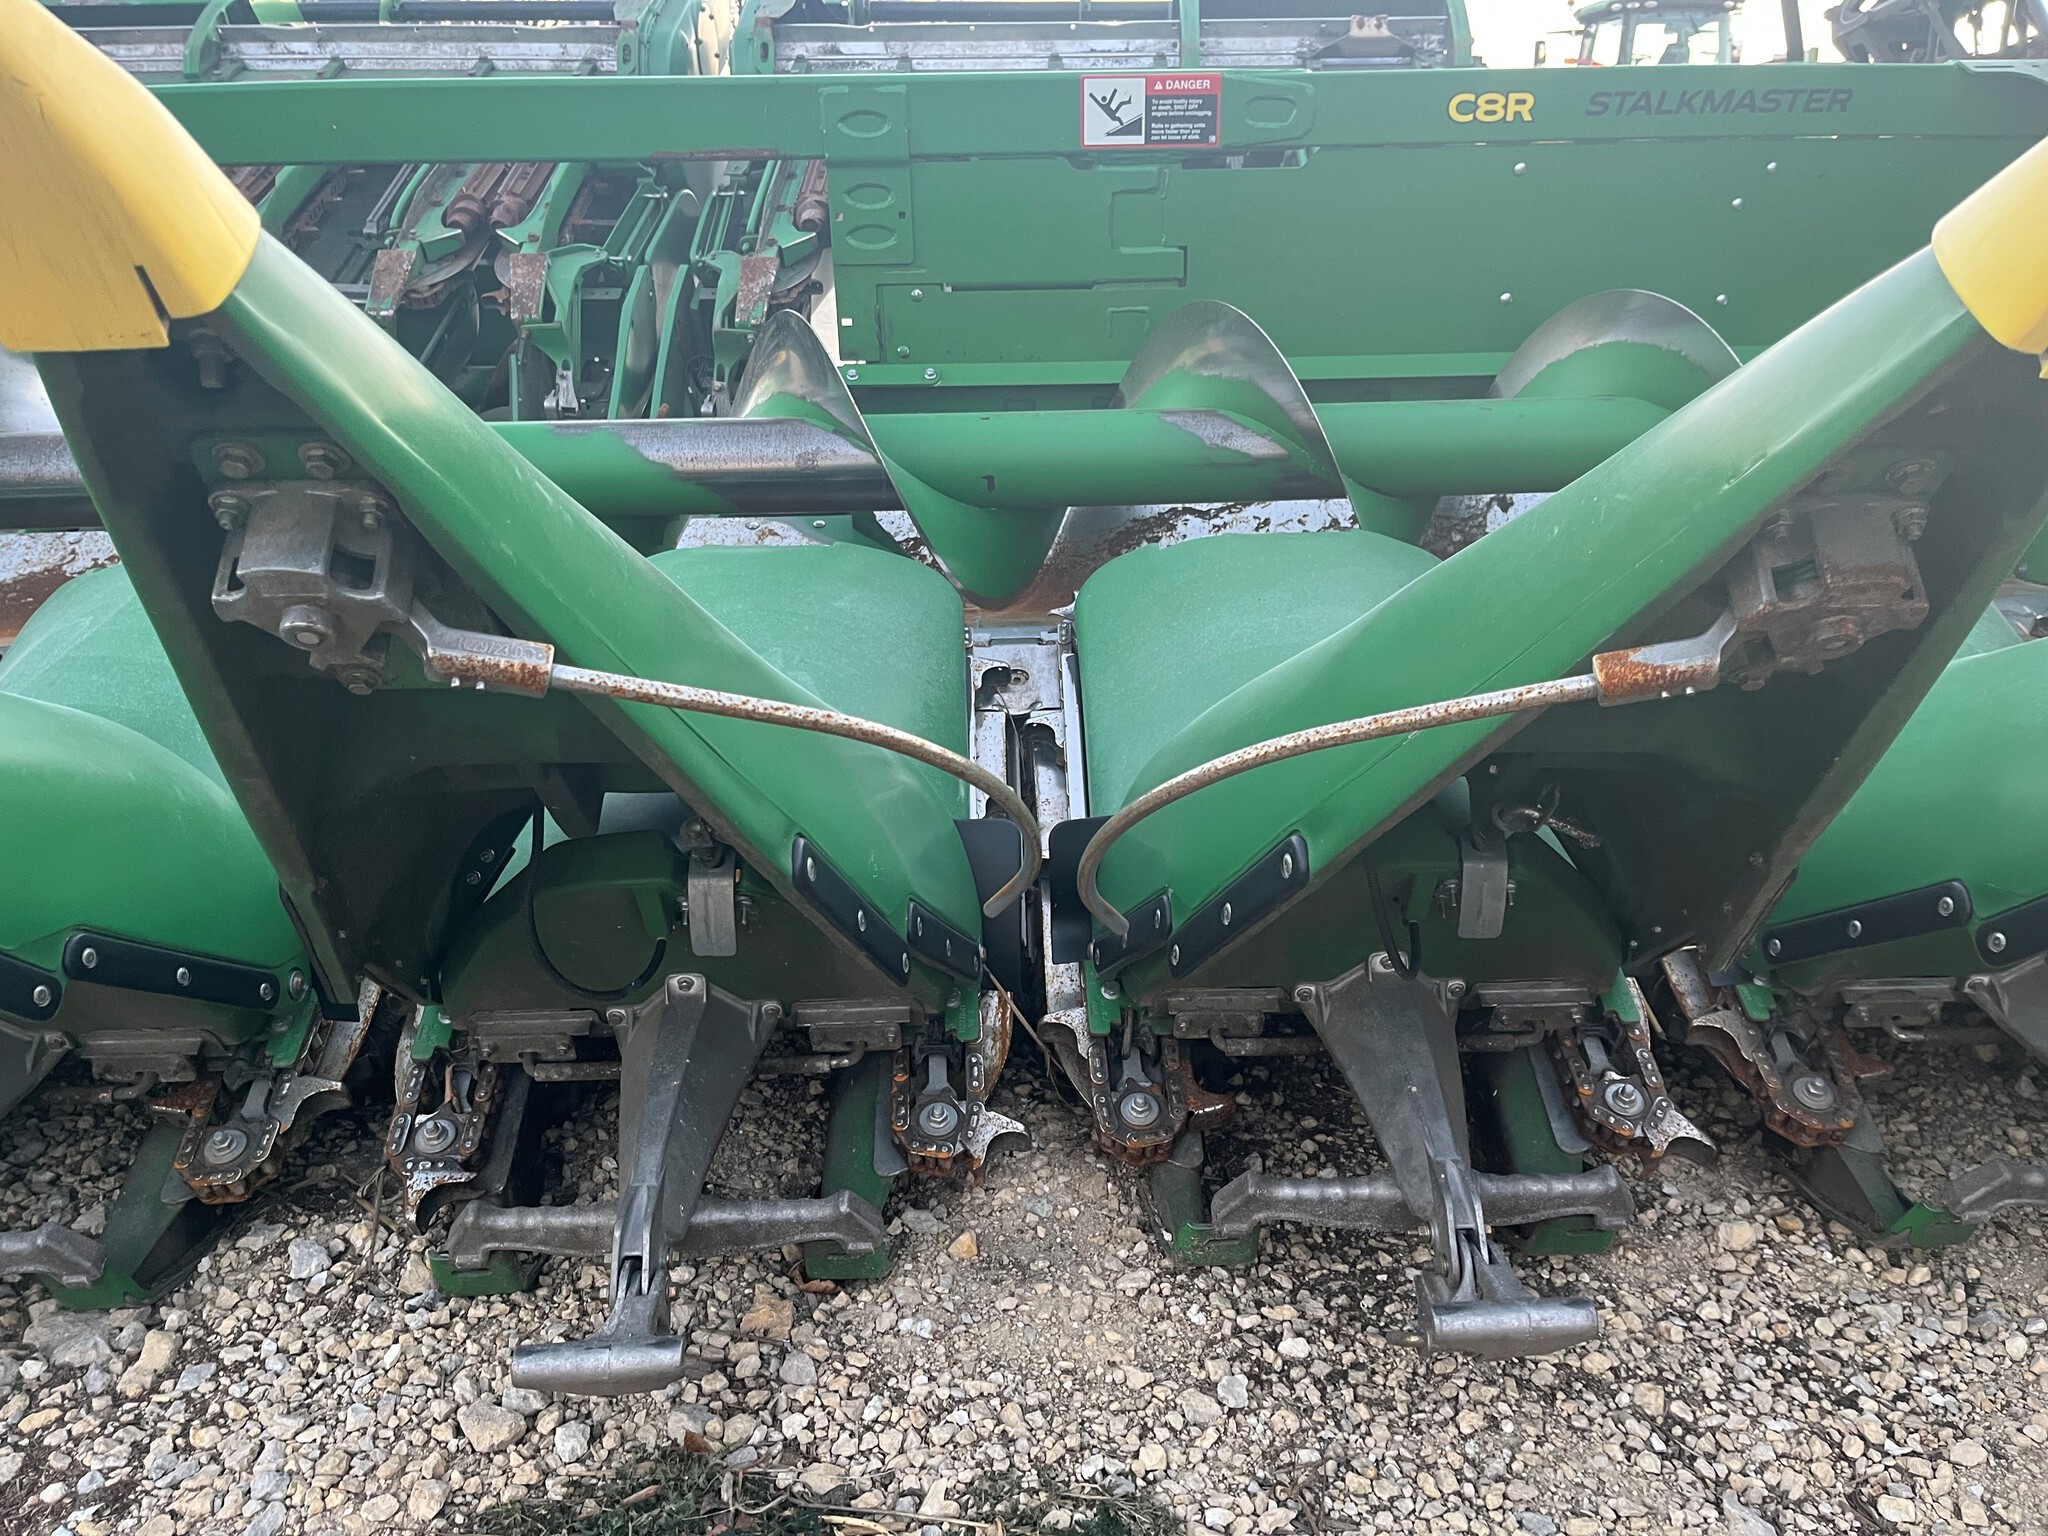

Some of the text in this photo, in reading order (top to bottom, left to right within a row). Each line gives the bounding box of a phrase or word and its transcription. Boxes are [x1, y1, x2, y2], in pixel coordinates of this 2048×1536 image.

[1165, 79, 1211, 90] DANGER
[1448, 91, 1535, 123] C8R
[1585, 88, 1854, 117] STALKMASTER
